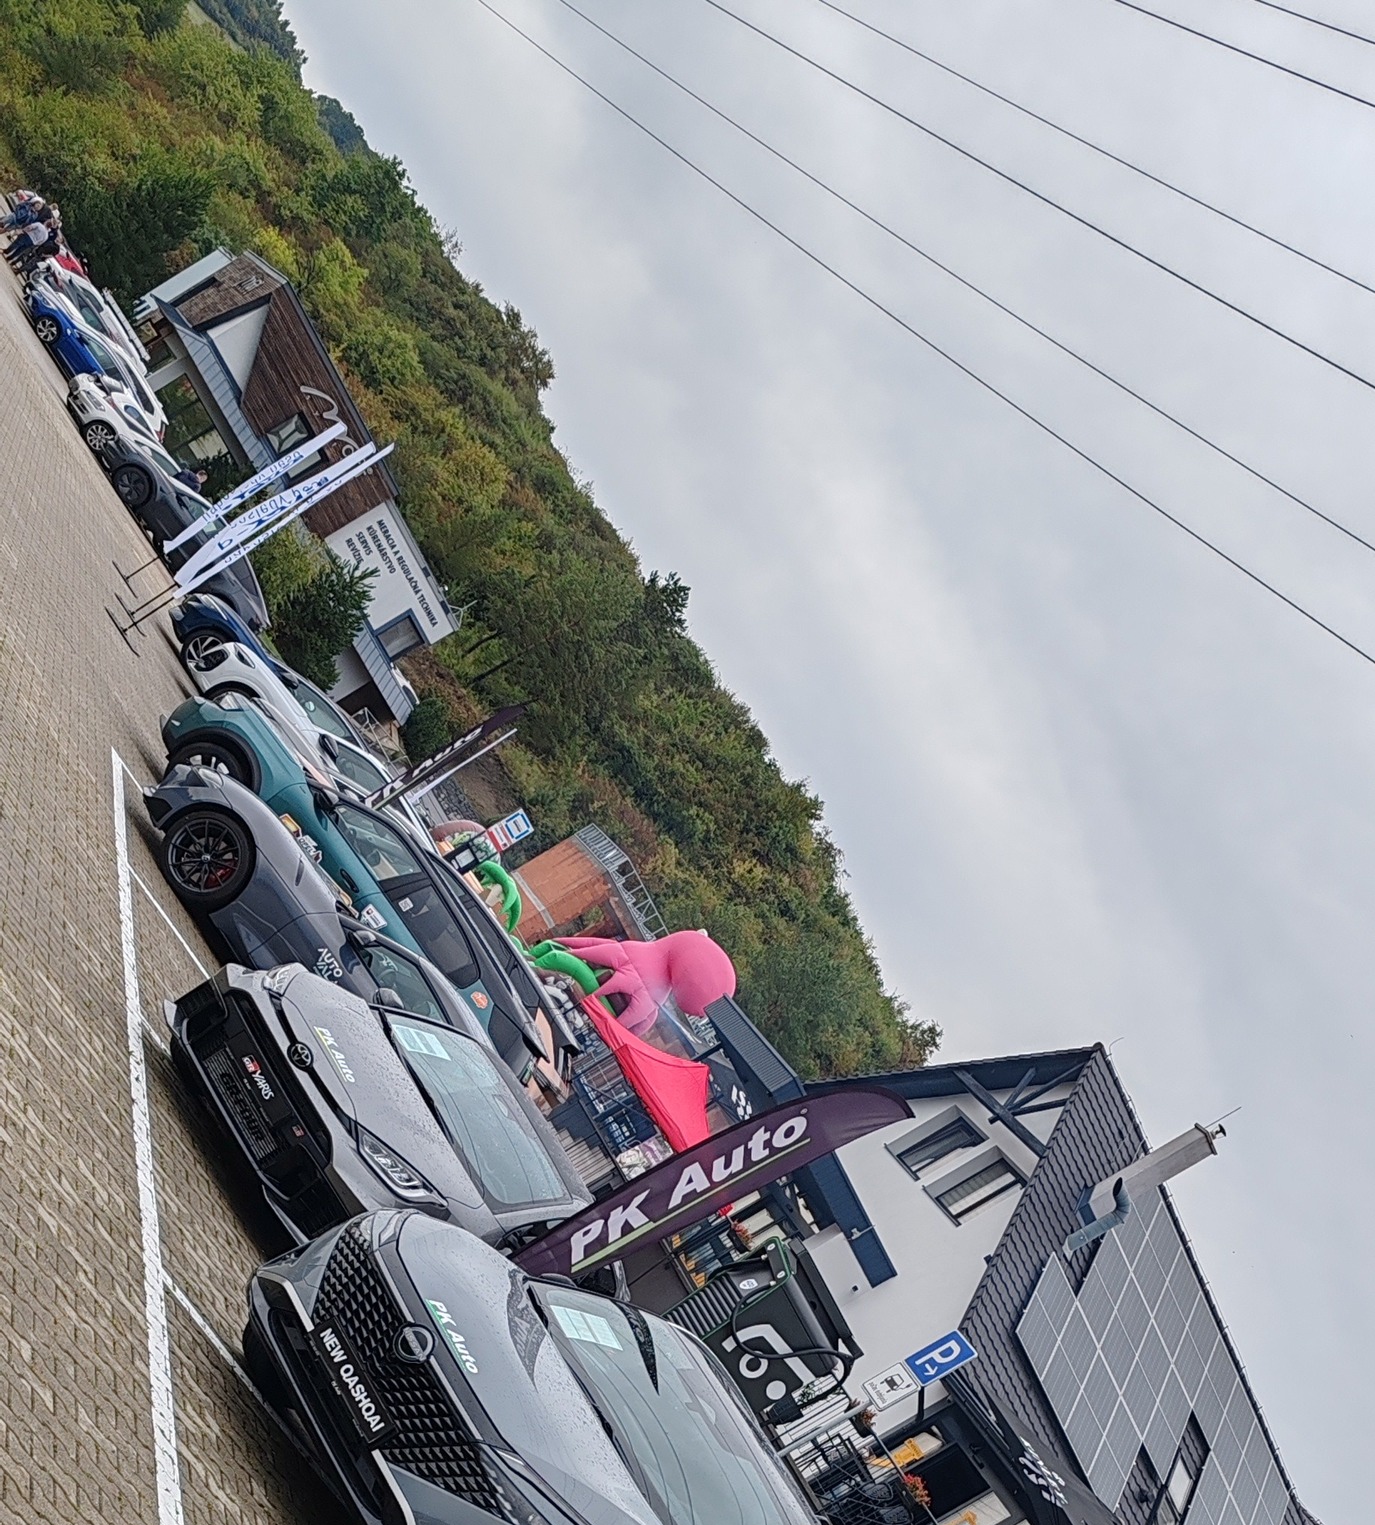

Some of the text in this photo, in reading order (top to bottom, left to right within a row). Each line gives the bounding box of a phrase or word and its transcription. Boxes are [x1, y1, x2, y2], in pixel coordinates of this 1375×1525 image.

[354, 530, 373, 556] SERVIS
[375, 518, 439, 627] MERACIA A REGULAČNÁ TECHNIKA
[316, 946, 344, 979] AUTO
[317, 1027, 355, 1082] PK Auto
[571, 1115, 808, 1265] PK Auto
[428, 1299, 478, 1373] PK Auto
[915, 1340, 961, 1366] P
[318, 1327, 385, 1432] NEW QASHQAI
